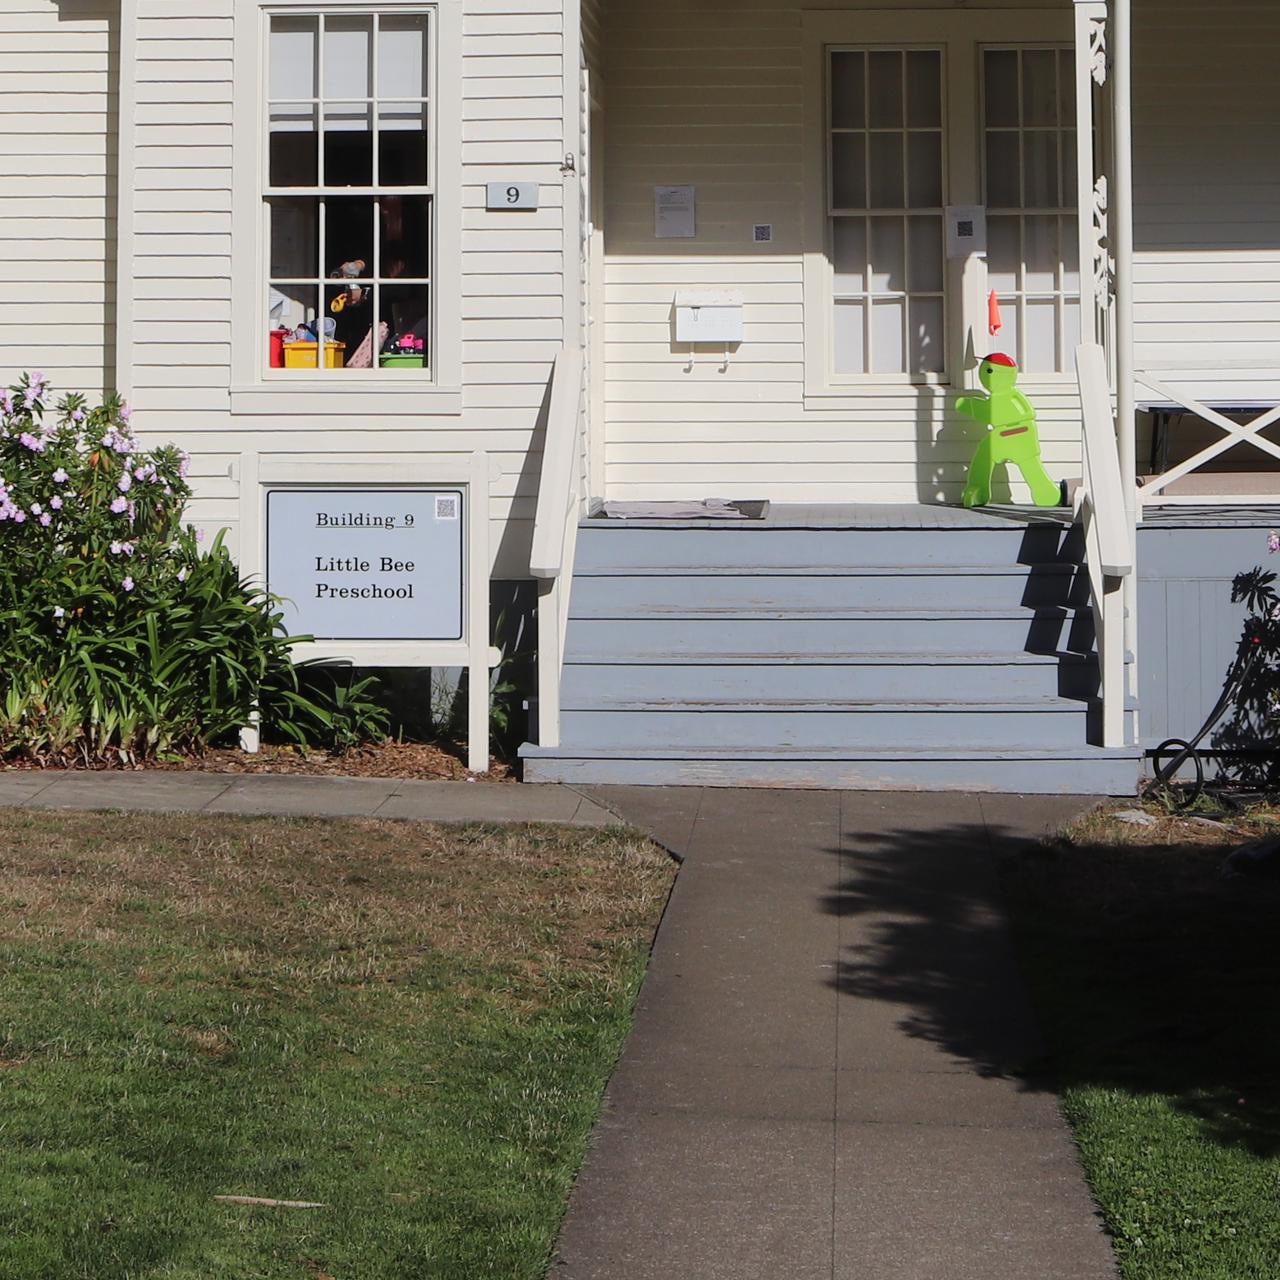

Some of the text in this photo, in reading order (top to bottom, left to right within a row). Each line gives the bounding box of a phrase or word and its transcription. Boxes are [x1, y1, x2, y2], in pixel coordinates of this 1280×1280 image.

[506, 186, 520, 204] 9
[315, 512, 415, 529] Building 9
[315, 556, 415, 572] Little Bee
[315, 583, 414, 599] Preschool
